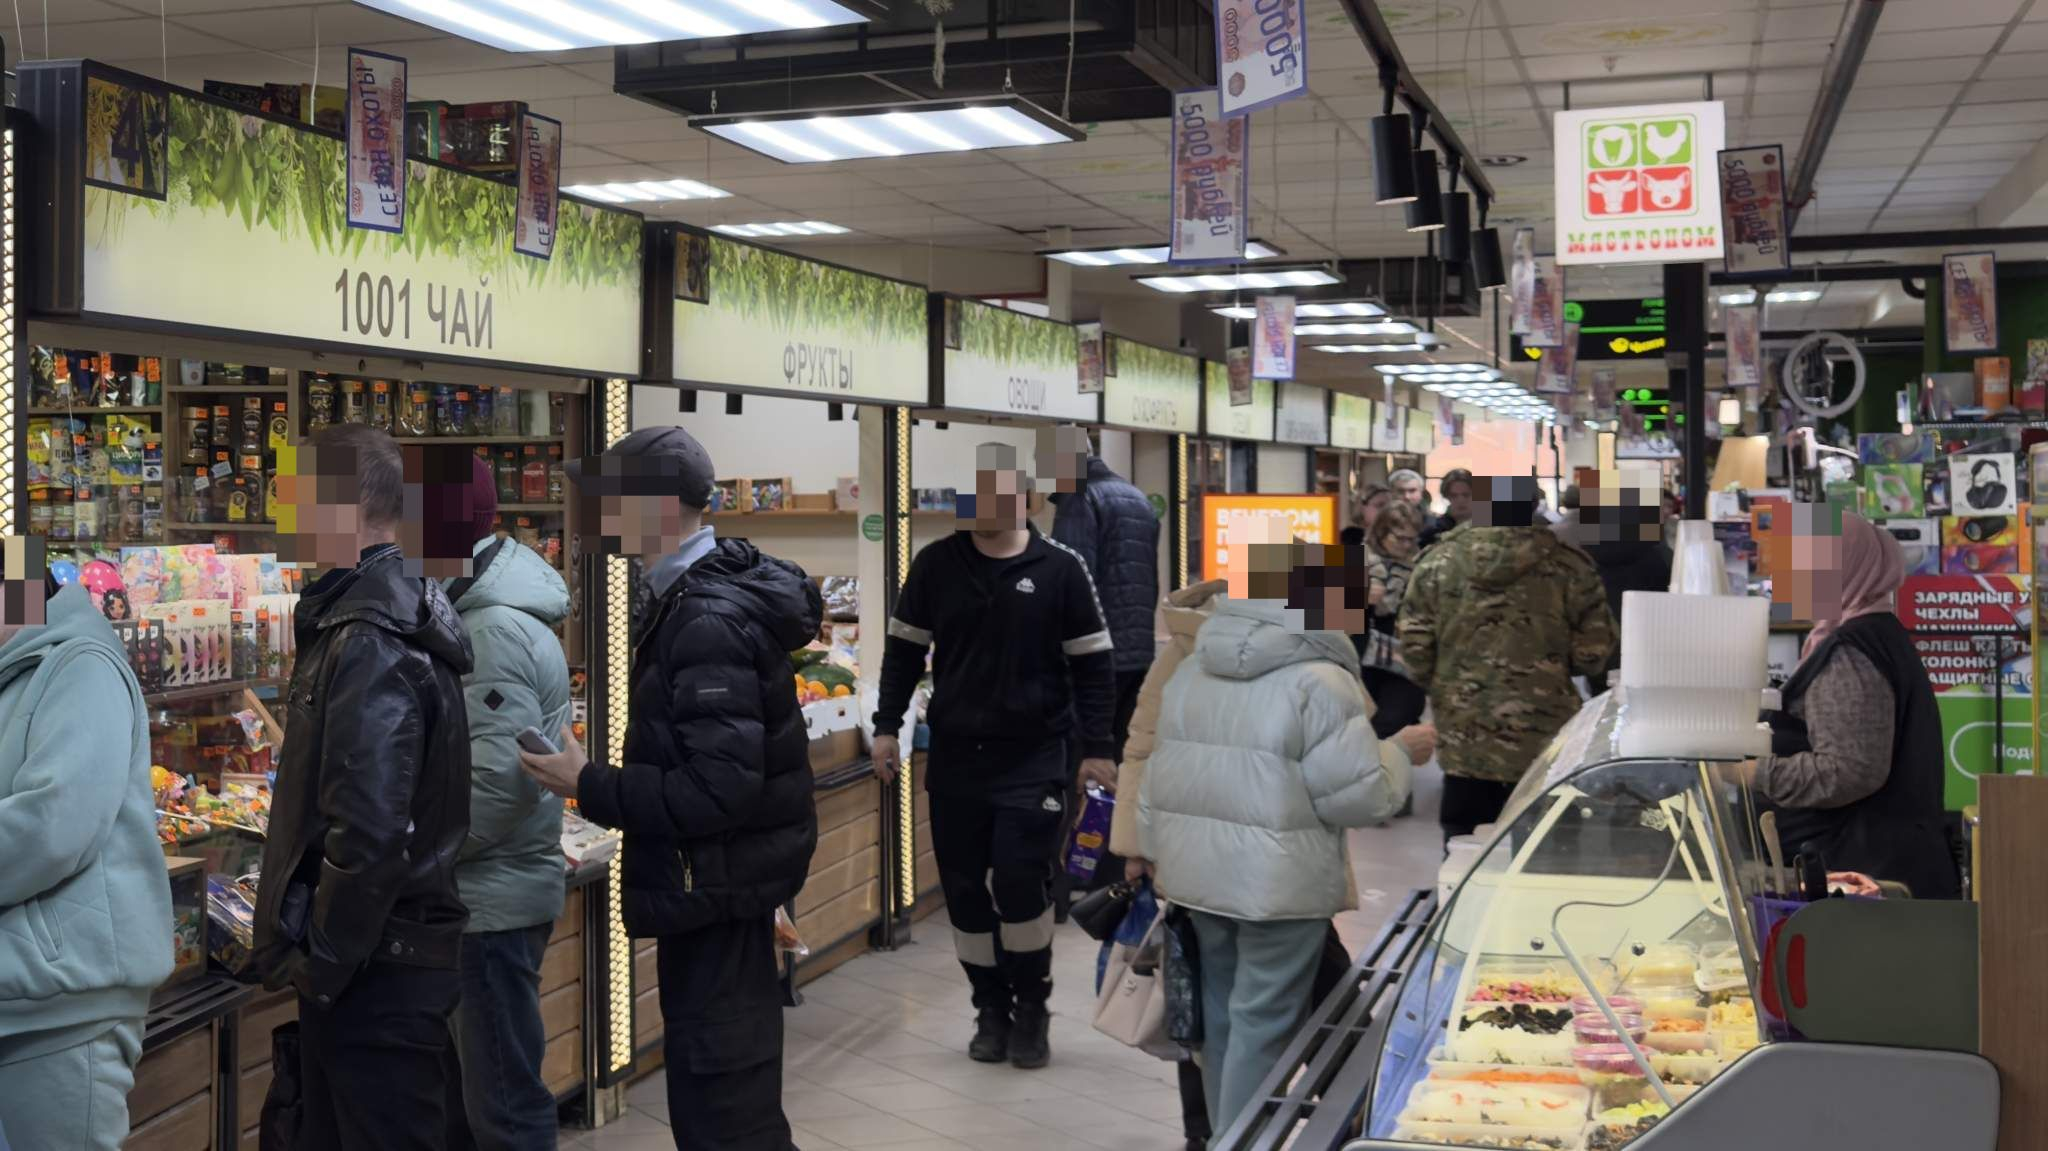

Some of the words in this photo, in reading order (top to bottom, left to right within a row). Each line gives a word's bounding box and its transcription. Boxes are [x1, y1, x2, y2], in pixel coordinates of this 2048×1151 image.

[356, 66, 386, 142] ОХОТЫ
[1180, 103, 1212, 157] 5000
[335, 268, 411, 339] 1001
[428, 276, 492, 349] ЧАЙ
[783, 341, 852, 390] ФРУКТЫ
[1008, 376, 1046, 412] ОВОЩИ
[1915, 591, 2014, 604] ЗАРЯДНЫЕ
[1915, 607, 1979, 620] ЧЕХЛЫ
[1915, 640, 1970, 652] ФЛЕШ
[1928, 672, 2021, 686] АЩИТНЫЕ
